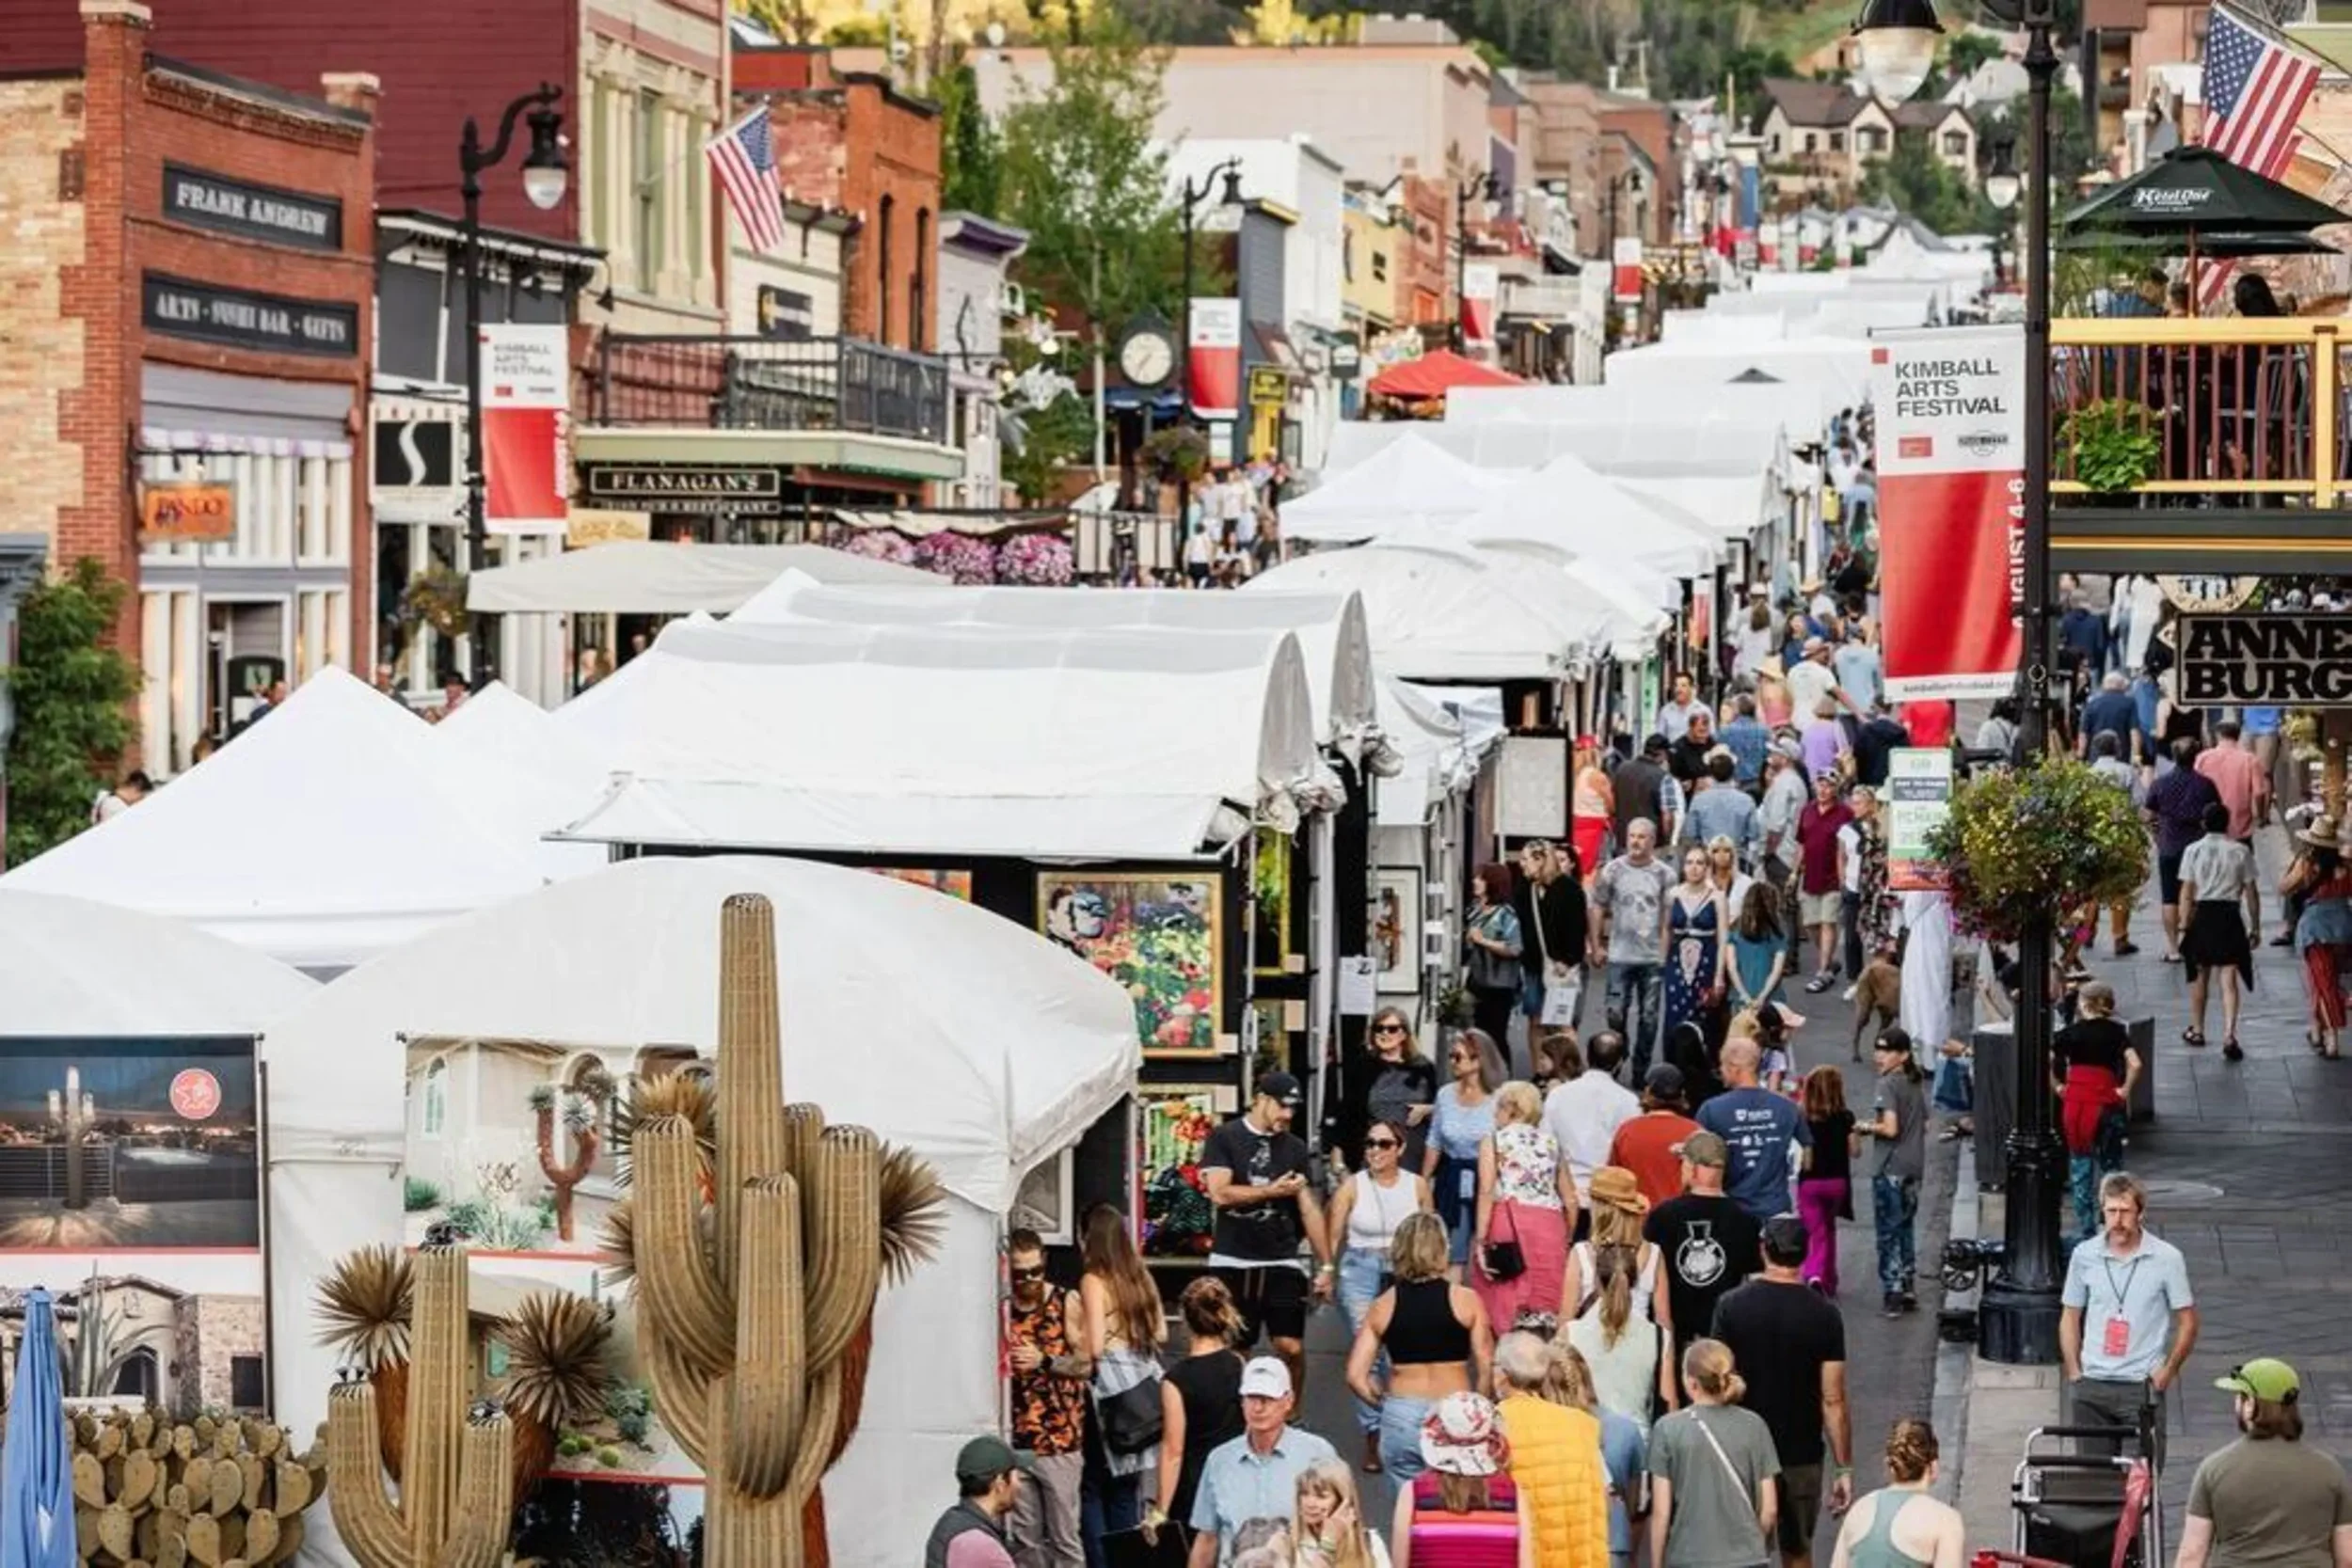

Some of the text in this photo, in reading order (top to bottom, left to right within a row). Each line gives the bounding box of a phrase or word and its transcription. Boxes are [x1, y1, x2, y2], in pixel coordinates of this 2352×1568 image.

[176, 182, 327, 235] FRANK ANDREW
[155, 293, 200, 322] ARTS
[1896, 358, 1999, 378] KIMBALL
[1897, 380, 1960, 397] ARTS
[1898, 397, 2007, 417] FESTIVAL
[612, 474, 758, 491] FLANAGAN'S
[2185, 620, 2351, 659] ANNE
[2185, 662, 2351, 700] BURG
